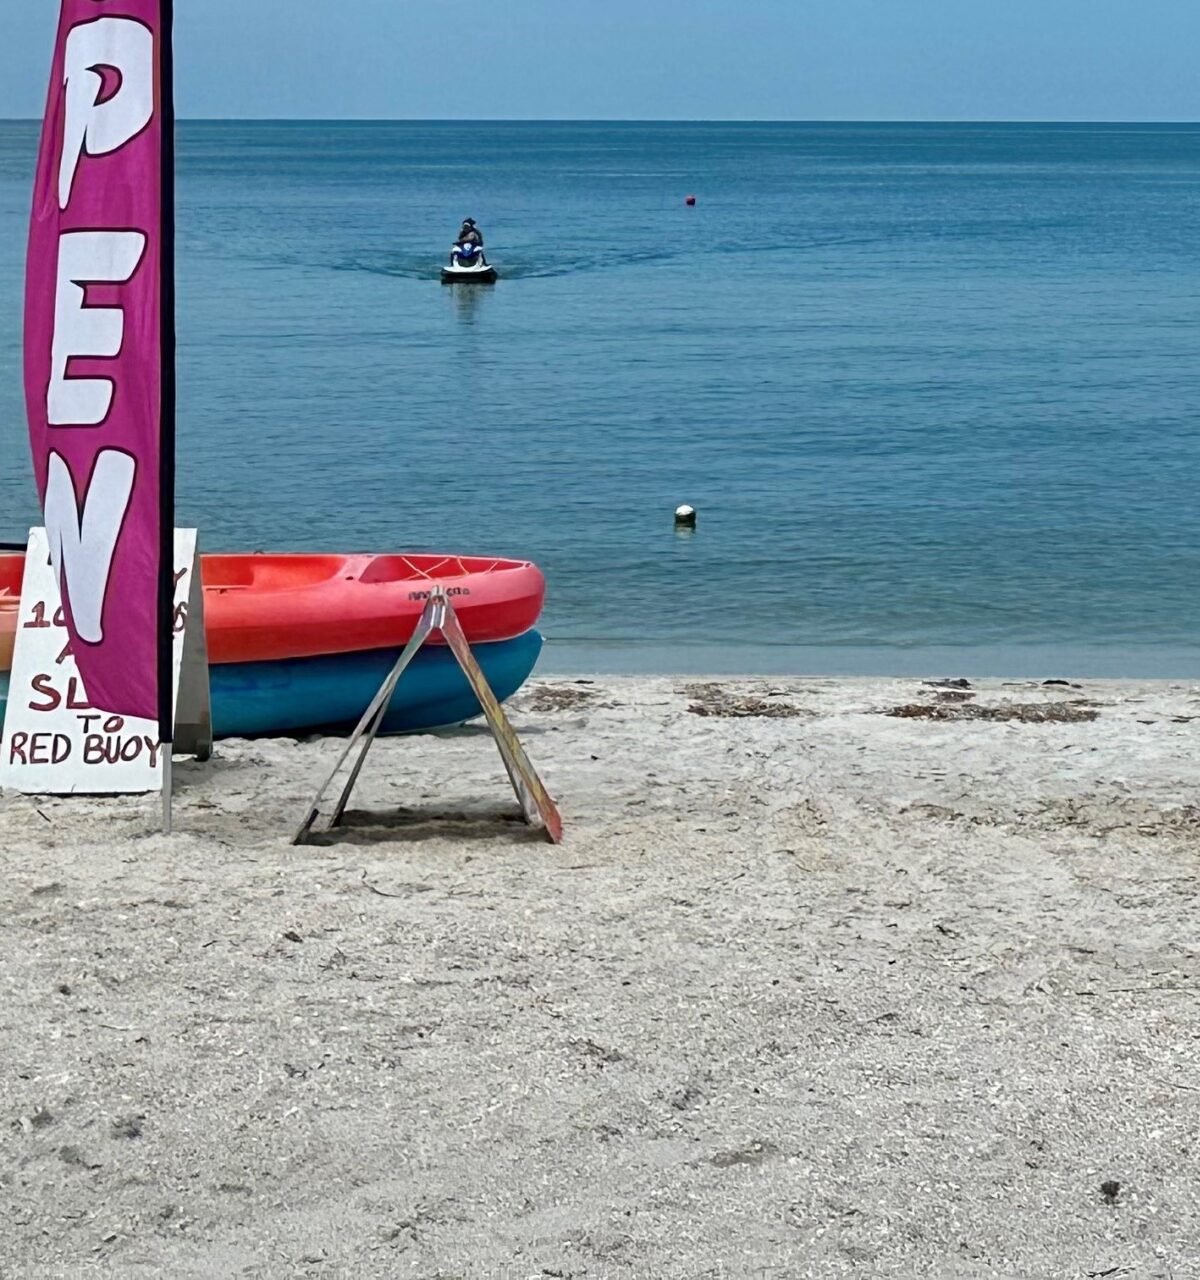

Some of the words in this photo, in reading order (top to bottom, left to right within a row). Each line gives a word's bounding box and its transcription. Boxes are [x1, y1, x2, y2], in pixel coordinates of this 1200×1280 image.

[77, 715, 124, 733] TO
[10, 732, 71, 765] RED
[83, 734, 161, 768] BUOY
